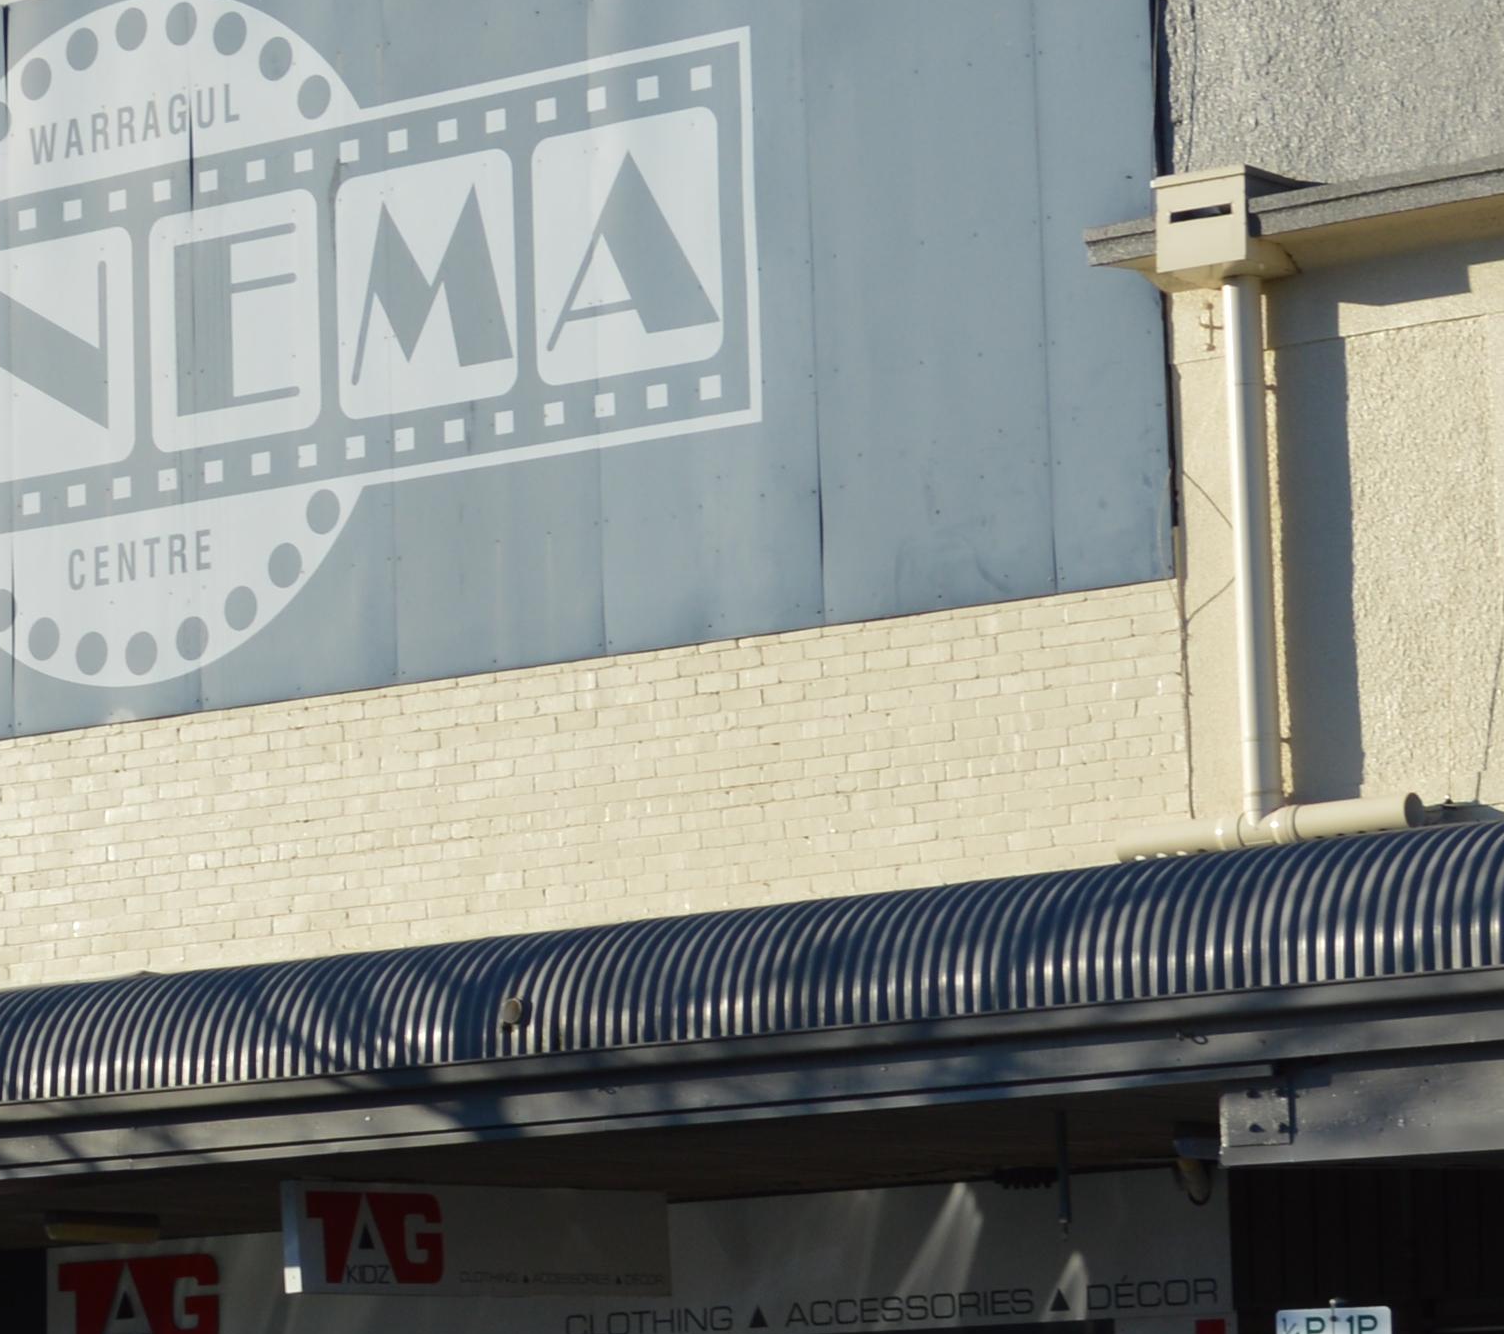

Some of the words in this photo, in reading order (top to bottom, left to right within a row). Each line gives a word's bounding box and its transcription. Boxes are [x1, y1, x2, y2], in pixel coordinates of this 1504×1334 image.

[29, 81, 242, 166] WARRAGUL
[67, 528, 214, 592] CENTRE
[306, 1191, 444, 1284] TAG
[346, 1264, 390, 1285] KIDZ
[459, 1270, 519, 1285] CLOTHING
[785, 1287, 1035, 1328] ACCESSORIES
[1086, 1275, 1219, 1312] DÉCOR
